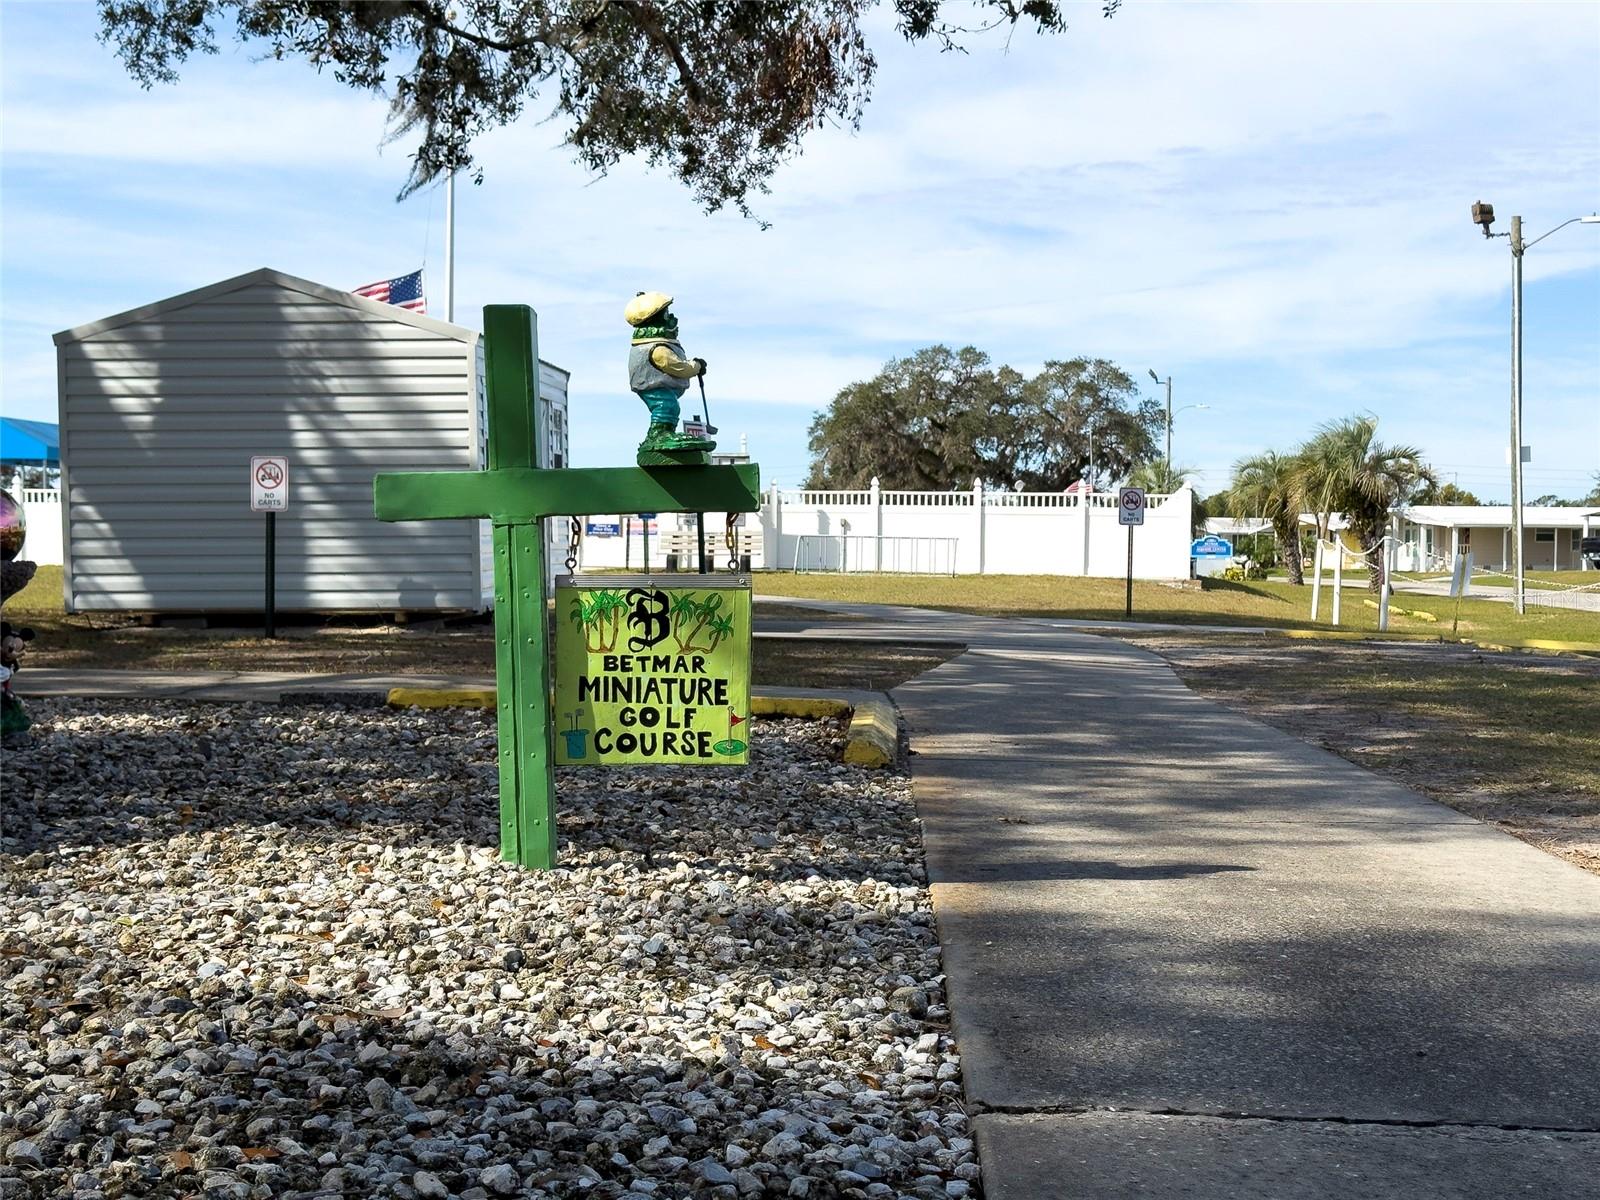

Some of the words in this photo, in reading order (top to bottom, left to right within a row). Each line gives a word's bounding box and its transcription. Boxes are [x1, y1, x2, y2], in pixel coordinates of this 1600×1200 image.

[626, 587, 671, 653] B
[603, 655, 707, 673] BETMAR
[579, 675, 728, 706] MINIATURE
[619, 706, 697, 729] GOLF
[594, 727, 713, 757] COURSE
